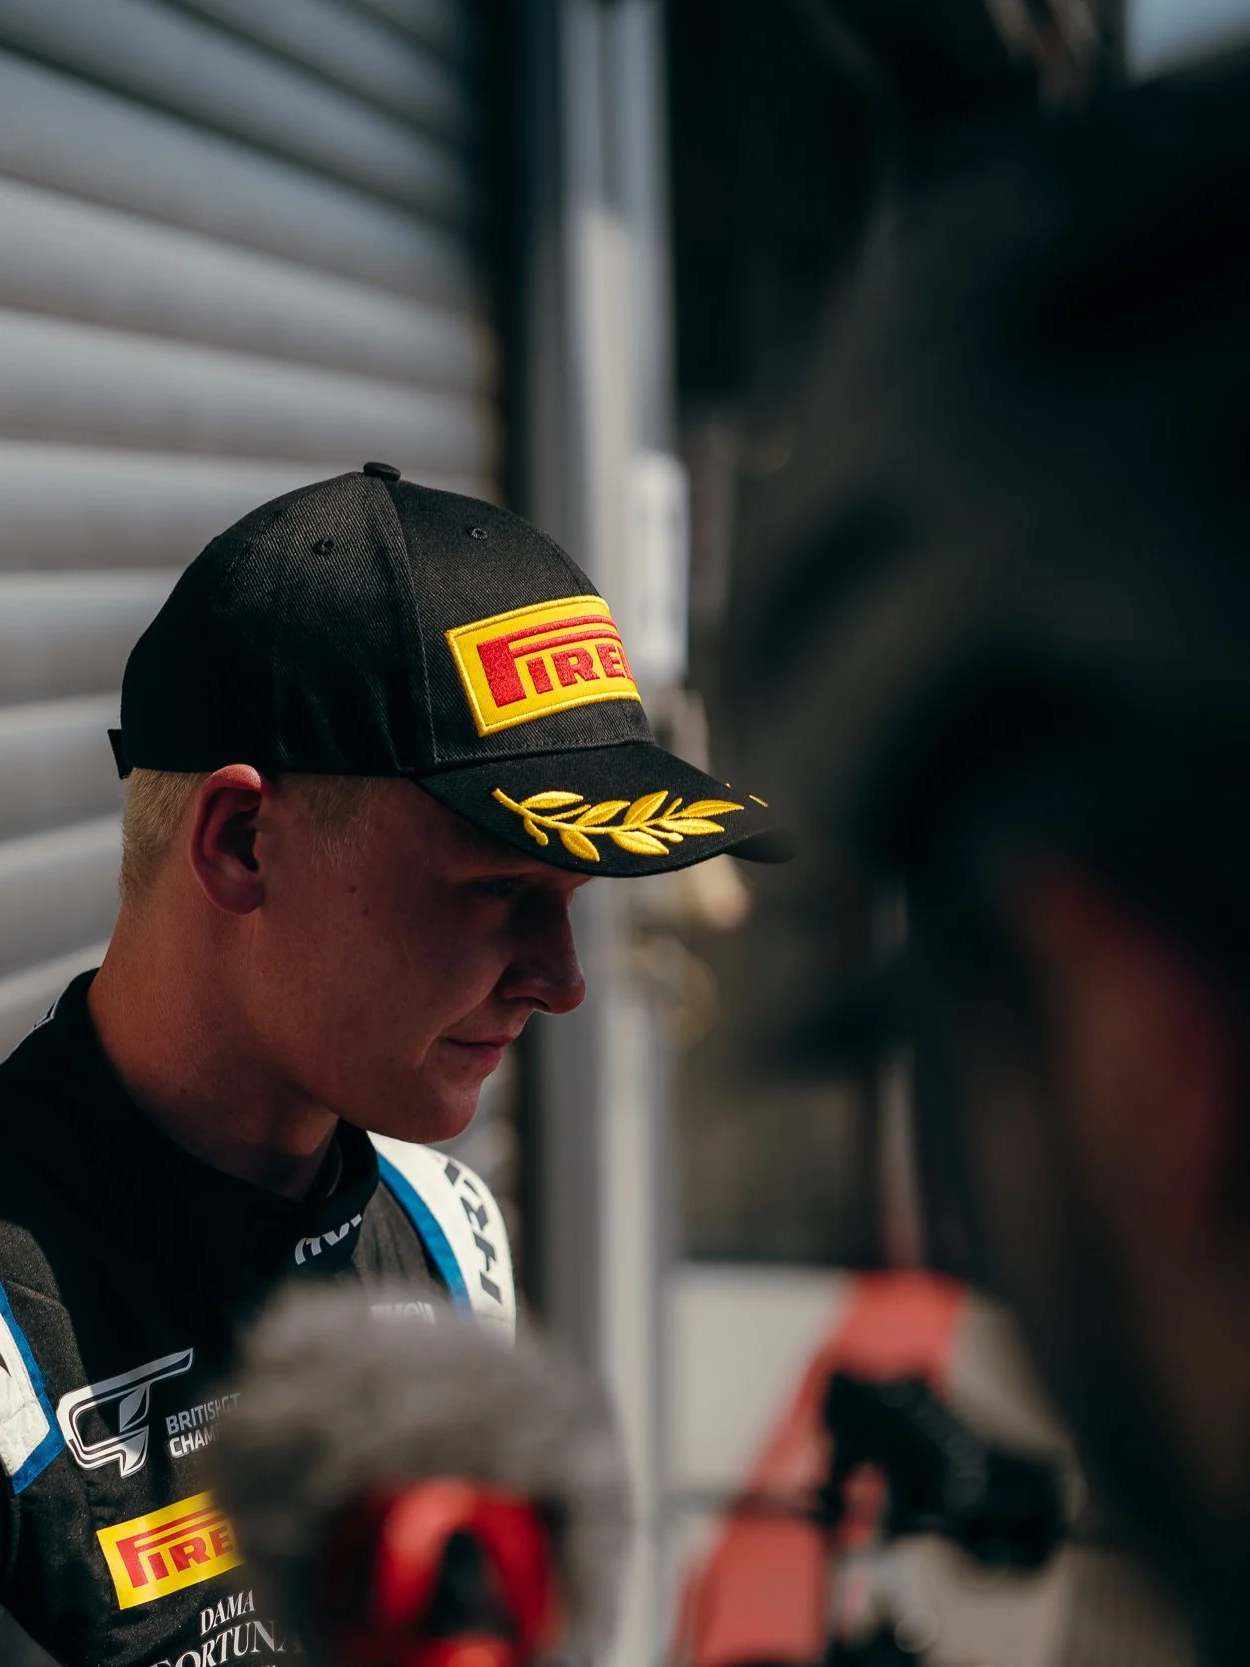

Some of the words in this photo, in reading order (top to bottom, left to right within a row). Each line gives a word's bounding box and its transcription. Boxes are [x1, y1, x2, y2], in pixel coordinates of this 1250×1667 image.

[477, 614, 634, 707] PIRE
[165, 1399, 223, 1435] BRITISH
[116, 1505, 237, 1588] PIRE
[201, 1589, 255, 1636] DAMA
